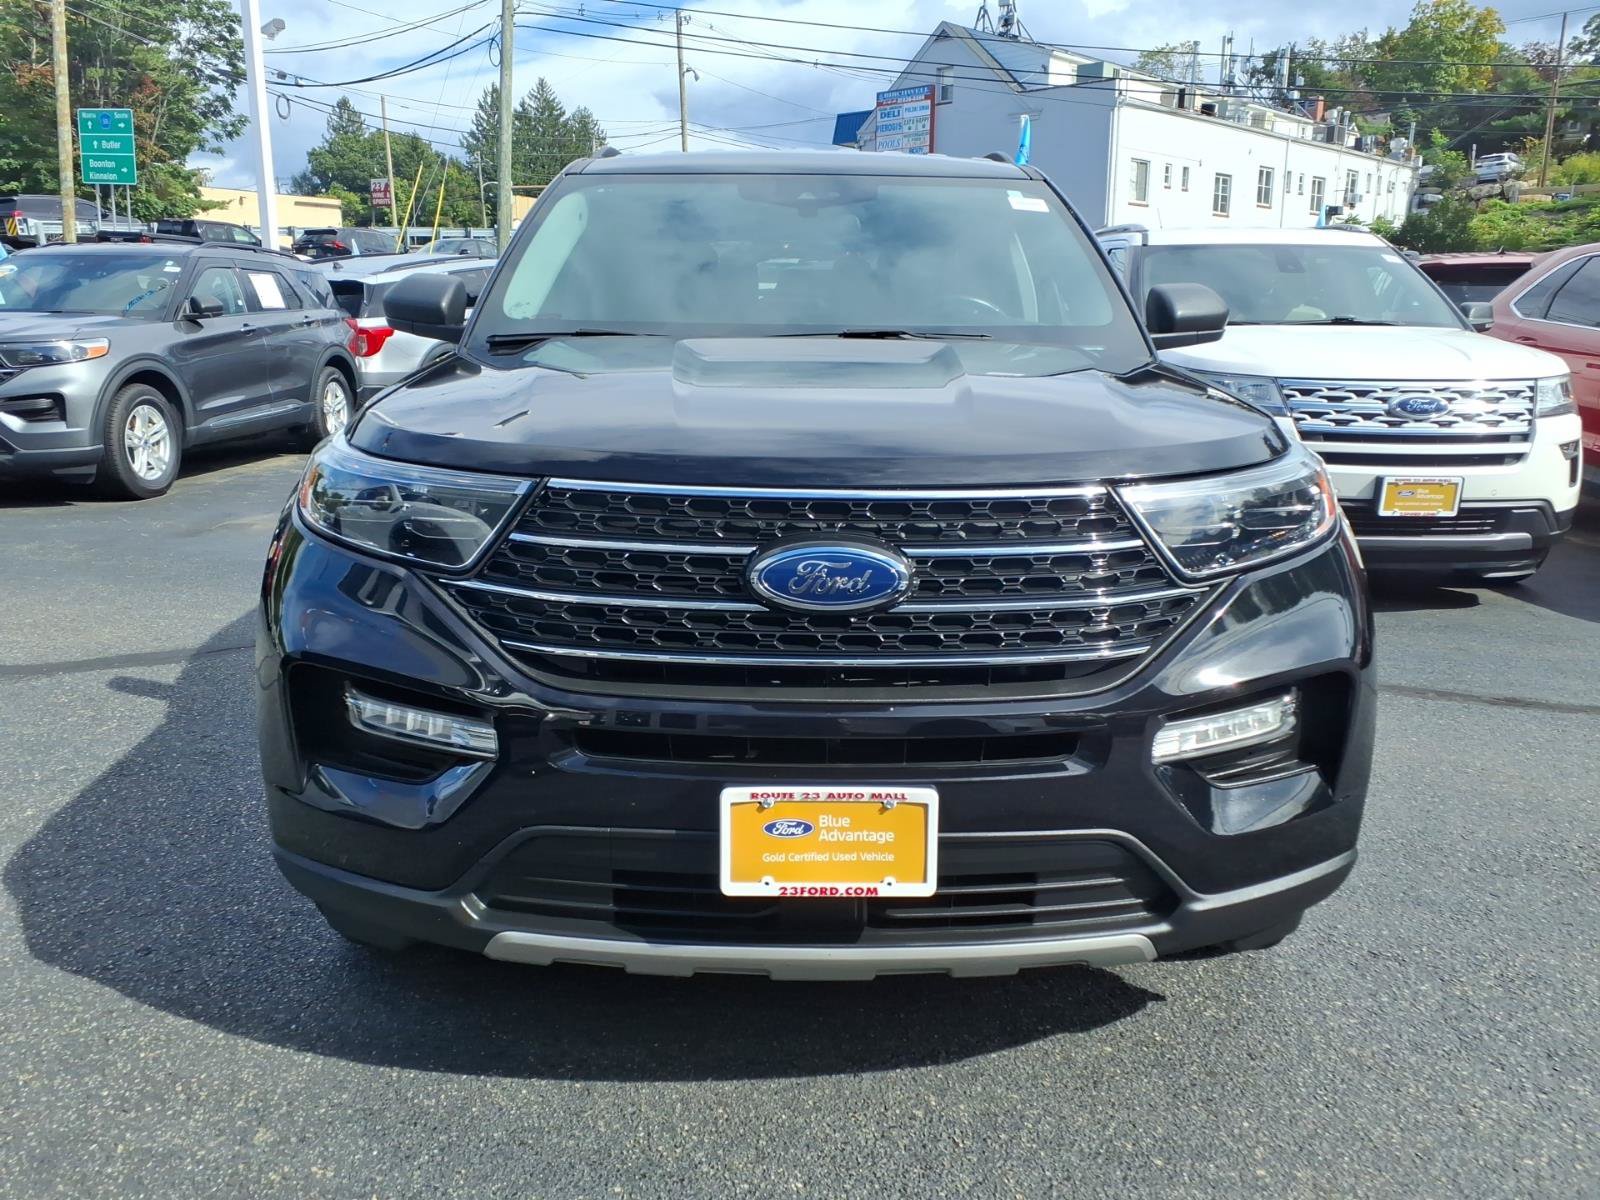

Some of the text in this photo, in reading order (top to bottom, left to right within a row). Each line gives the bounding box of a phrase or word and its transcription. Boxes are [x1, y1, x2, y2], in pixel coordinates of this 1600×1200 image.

[880, 110, 900, 119] DELI
[101, 140, 121, 149] Butler
[877, 139, 901, 150] POOLS
[89, 159, 116, 168] Boonton
[1407, 398, 1438, 412] Ford
[788, 560, 872, 595] Ford
[750, 792, 795, 800] ROUTE
[801, 792, 820, 800] 23
[827, 792, 865, 800] AUTO
[819, 815, 850, 828] Blue
[772, 821, 805, 836] Ford
[818, 829, 895, 845] Advantage
[762, 851, 895, 862] Gold Certified Used Vehicle
[779, 886, 879, 896] 23FORD.COM
